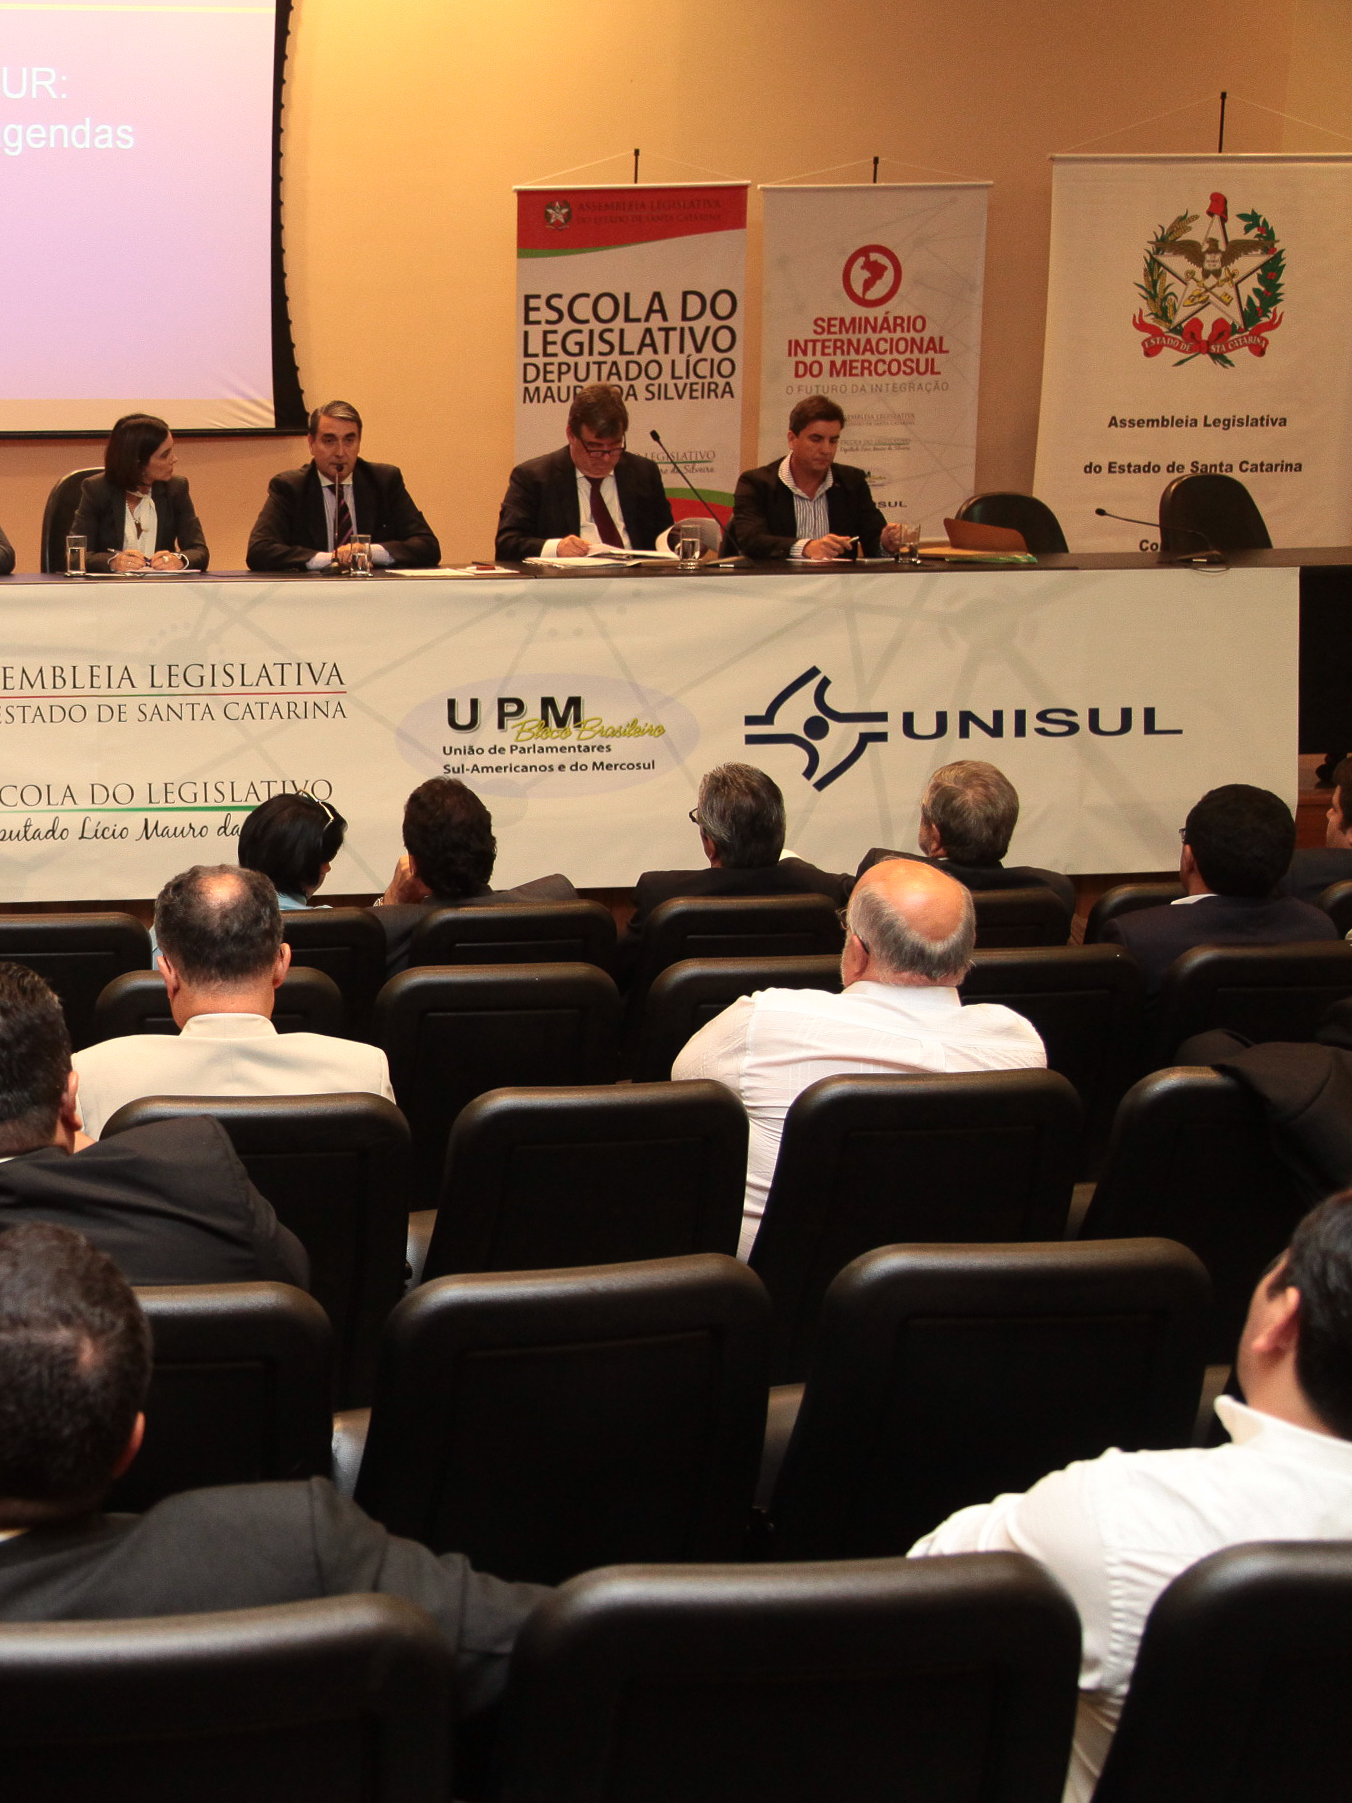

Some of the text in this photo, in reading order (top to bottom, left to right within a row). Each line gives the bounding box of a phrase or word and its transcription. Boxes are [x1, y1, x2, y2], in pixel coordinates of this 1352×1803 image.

[523, 288, 738, 326] ESCOLA DO
[812, 311, 927, 336] SEMINÁRIO
[522, 325, 737, 358] LEGISLATIVO
[786, 336, 950, 358] INTERNACIONAL
[1144, 336, 1179, 348] ESTADO
[522, 354, 737, 384] DEPUTADO LÍCIO
[793, 357, 941, 379] DO MERCOSUL
[644, 381, 735, 401] SILVEIRA
[785, 380, 950, 395] O FUTURO DA INTEGRAÇÃO
[1107, 414, 1288, 431] Assembleia Legislativa
[1083, 460, 1303, 474] do Estado de Santa Catarina
[149, 662, 346, 689] LEGISLATIVA
[97, 703, 128, 723] DE
[137, 702, 216, 722] SANTA
[223, 700, 348, 721] CATARINA
[901, 706, 1184, 740] UNISUL
[511, 716, 667, 742] Bloco Brasileiro
[442, 743, 612, 756] União de Parlamentares
[443, 760, 655, 774] Sul-Americanos e do Mercosul
[89, 783, 135, 806] DO
[147, 778, 333, 805] LEGISLATIVO
[78, 815, 130, 841] Lício
[135, 817, 209, 842] Mauro
[216, 812, 241, 838] da
